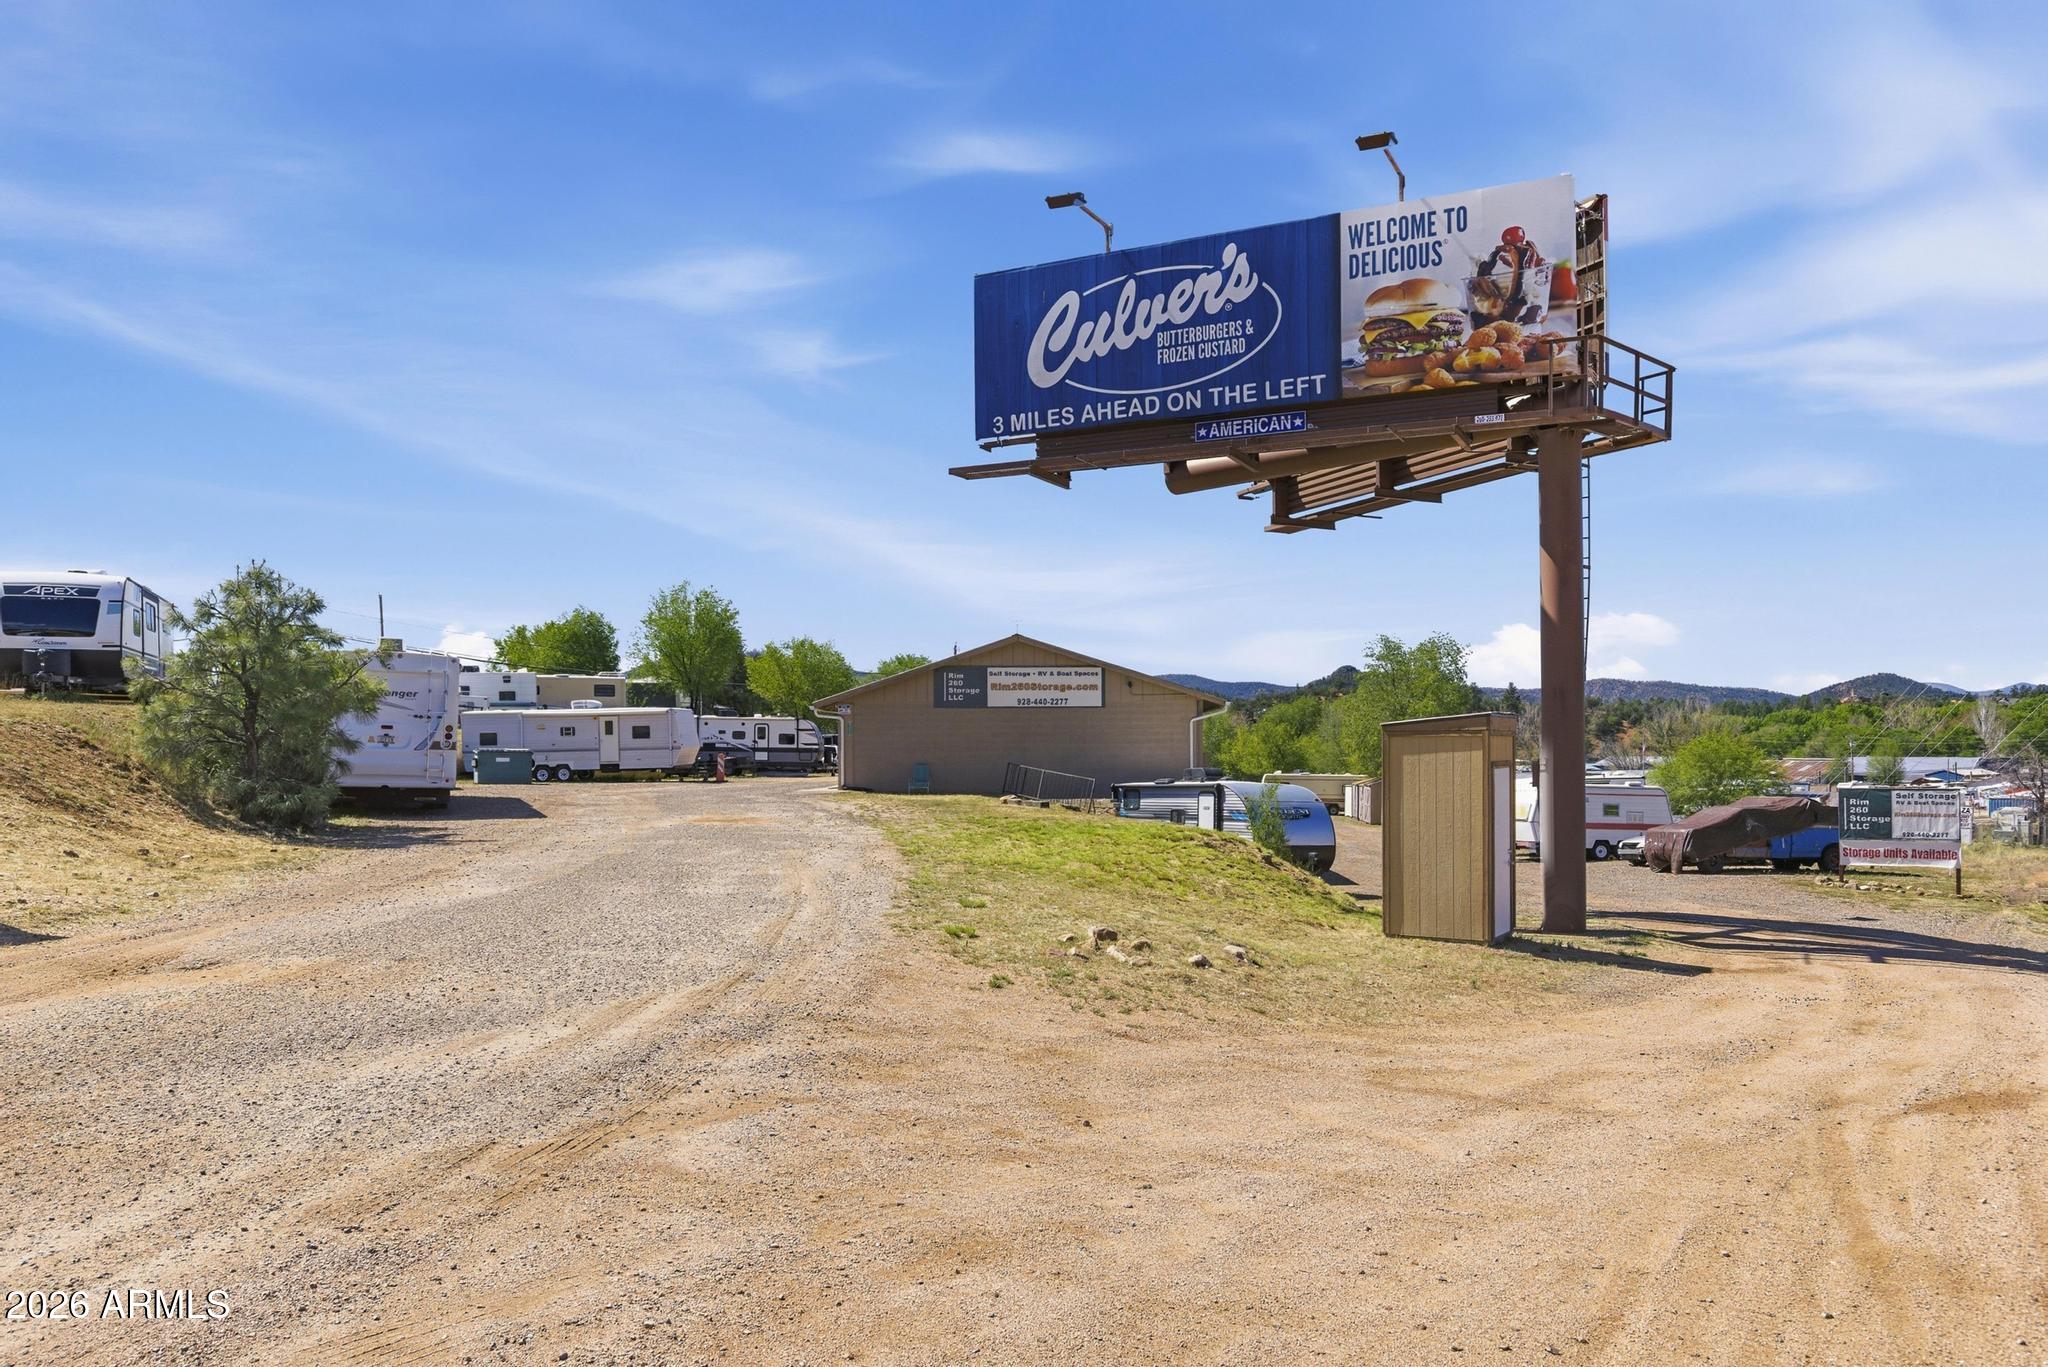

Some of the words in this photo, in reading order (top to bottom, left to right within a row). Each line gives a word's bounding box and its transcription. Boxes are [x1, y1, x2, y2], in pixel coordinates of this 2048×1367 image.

[1348, 210, 1437, 250] WELCOME
[1443, 205, 1468, 234] TO
[1348, 240, 1443, 280] DELICIOUS
[1027, 242, 1259, 388] Culver's
[1157, 320, 1243, 348] BUTTERBURGERS
[1245, 318, 1254, 335] &
[1157, 344, 1196, 365] FROZEN
[1198, 332, 1246, 359] CUSTARD
[993, 416, 1004, 434] 3
[1010, 406, 1075, 432] MILES
[1080, 396, 1161, 423] AHEAD
[1166, 389, 1201, 412] ON
[1208, 382, 1257, 406] THE
[1265, 374, 1327, 400] LEFT
[23, 586, 79, 596] APEX
[948, 687, 980, 695] Storage
[990, 682, 1099, 693] Rim260Storage.com
[1017, 698, 1069, 706] 928-440-2277
[1918, 793, 1957, 801] Storage
[1849, 815, 1891, 823] Storage
[1843, 847, 1881, 858] Storage
[1883, 848, 1908, 860] Units
[1911, 849, 1958, 860] Available
